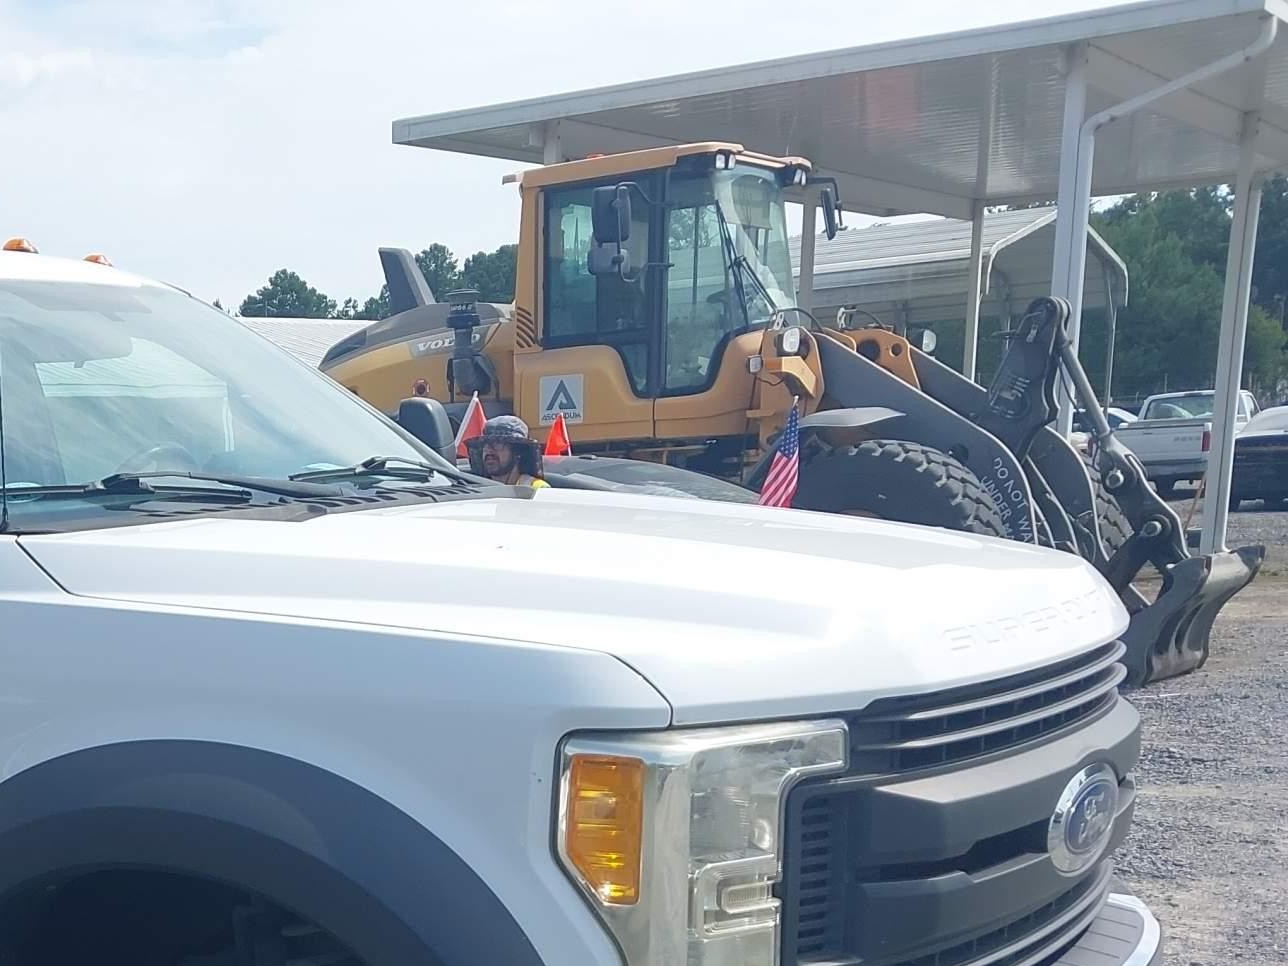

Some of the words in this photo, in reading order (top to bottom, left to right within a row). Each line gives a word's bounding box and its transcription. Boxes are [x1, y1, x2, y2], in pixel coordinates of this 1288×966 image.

[417, 333, 481, 351] VOLO
[981, 476, 1012, 520] UNDER
[1004, 480, 1029, 509] NOT
[938, 604, 1062, 653] SUPER
